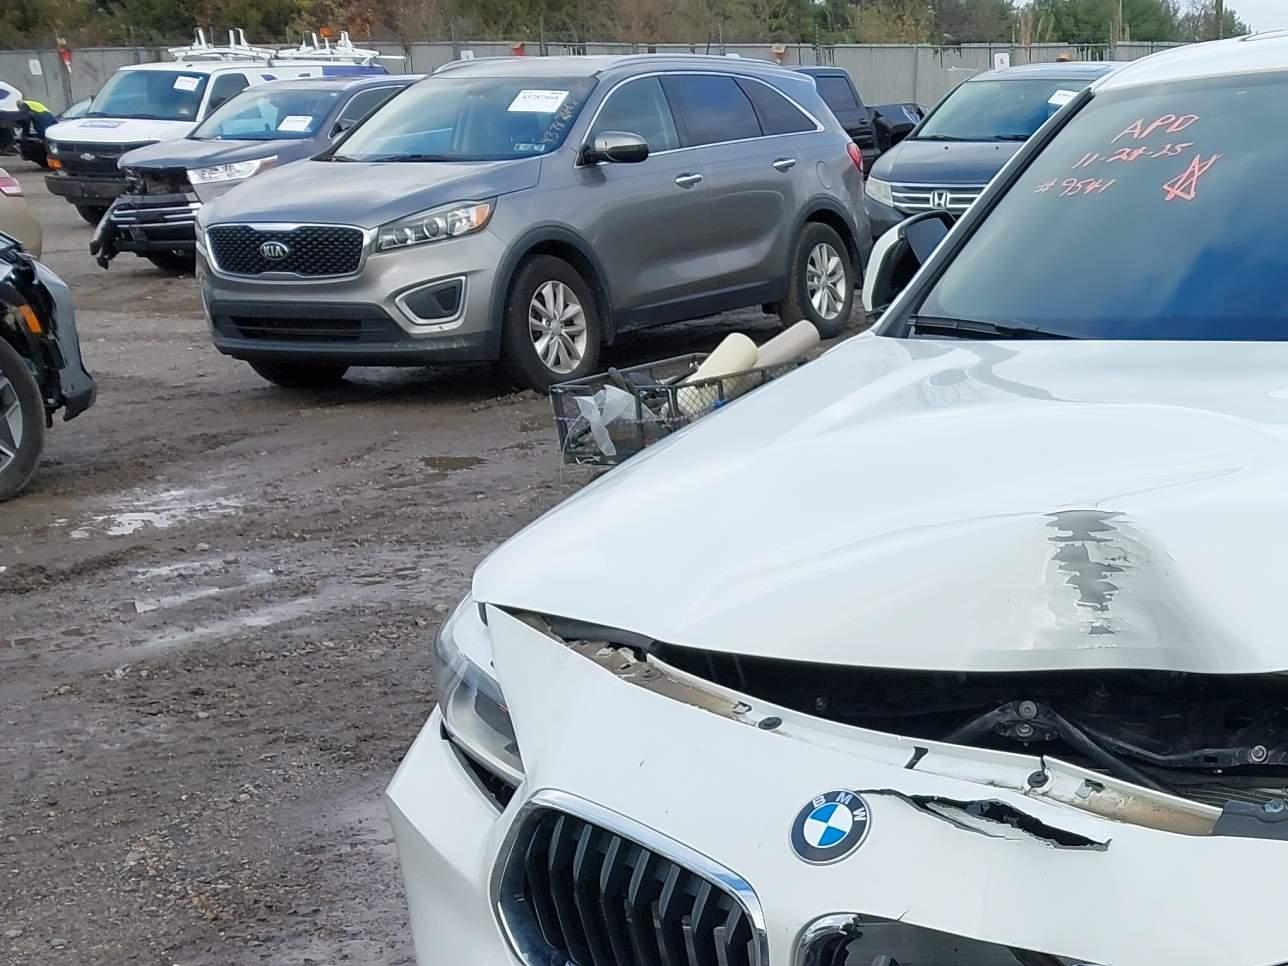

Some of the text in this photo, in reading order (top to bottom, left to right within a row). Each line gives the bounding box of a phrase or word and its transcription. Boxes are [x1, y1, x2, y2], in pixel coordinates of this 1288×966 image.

[1110, 113, 1200, 144] APD
[263, 245, 284, 257] KIA
[812, 791, 867, 822] BMW
